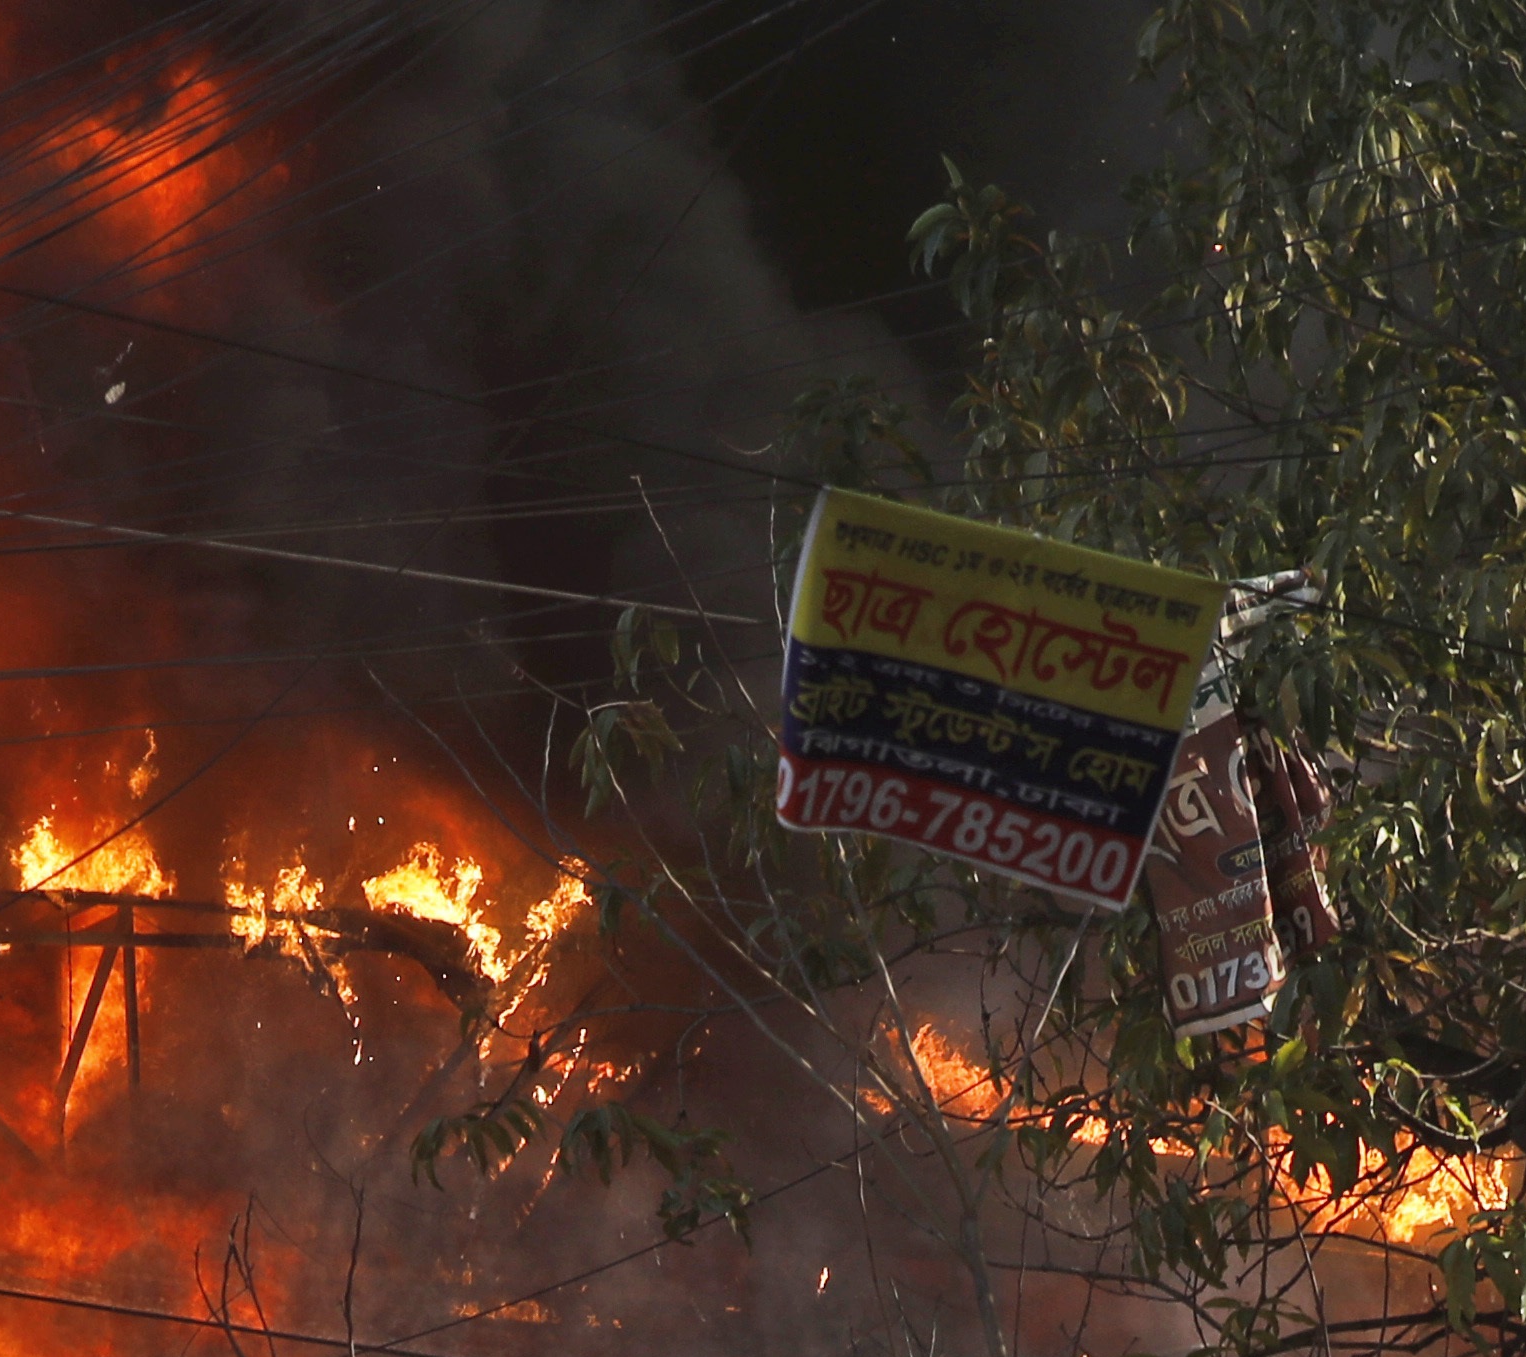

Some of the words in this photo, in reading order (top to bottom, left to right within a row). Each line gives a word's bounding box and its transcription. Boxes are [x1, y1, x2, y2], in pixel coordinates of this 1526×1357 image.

[819, 567, 934, 645] ছাত্র
[944, 598, 1192, 714] হোস্টেল
[1066, 743, 1161, 799] হোম
